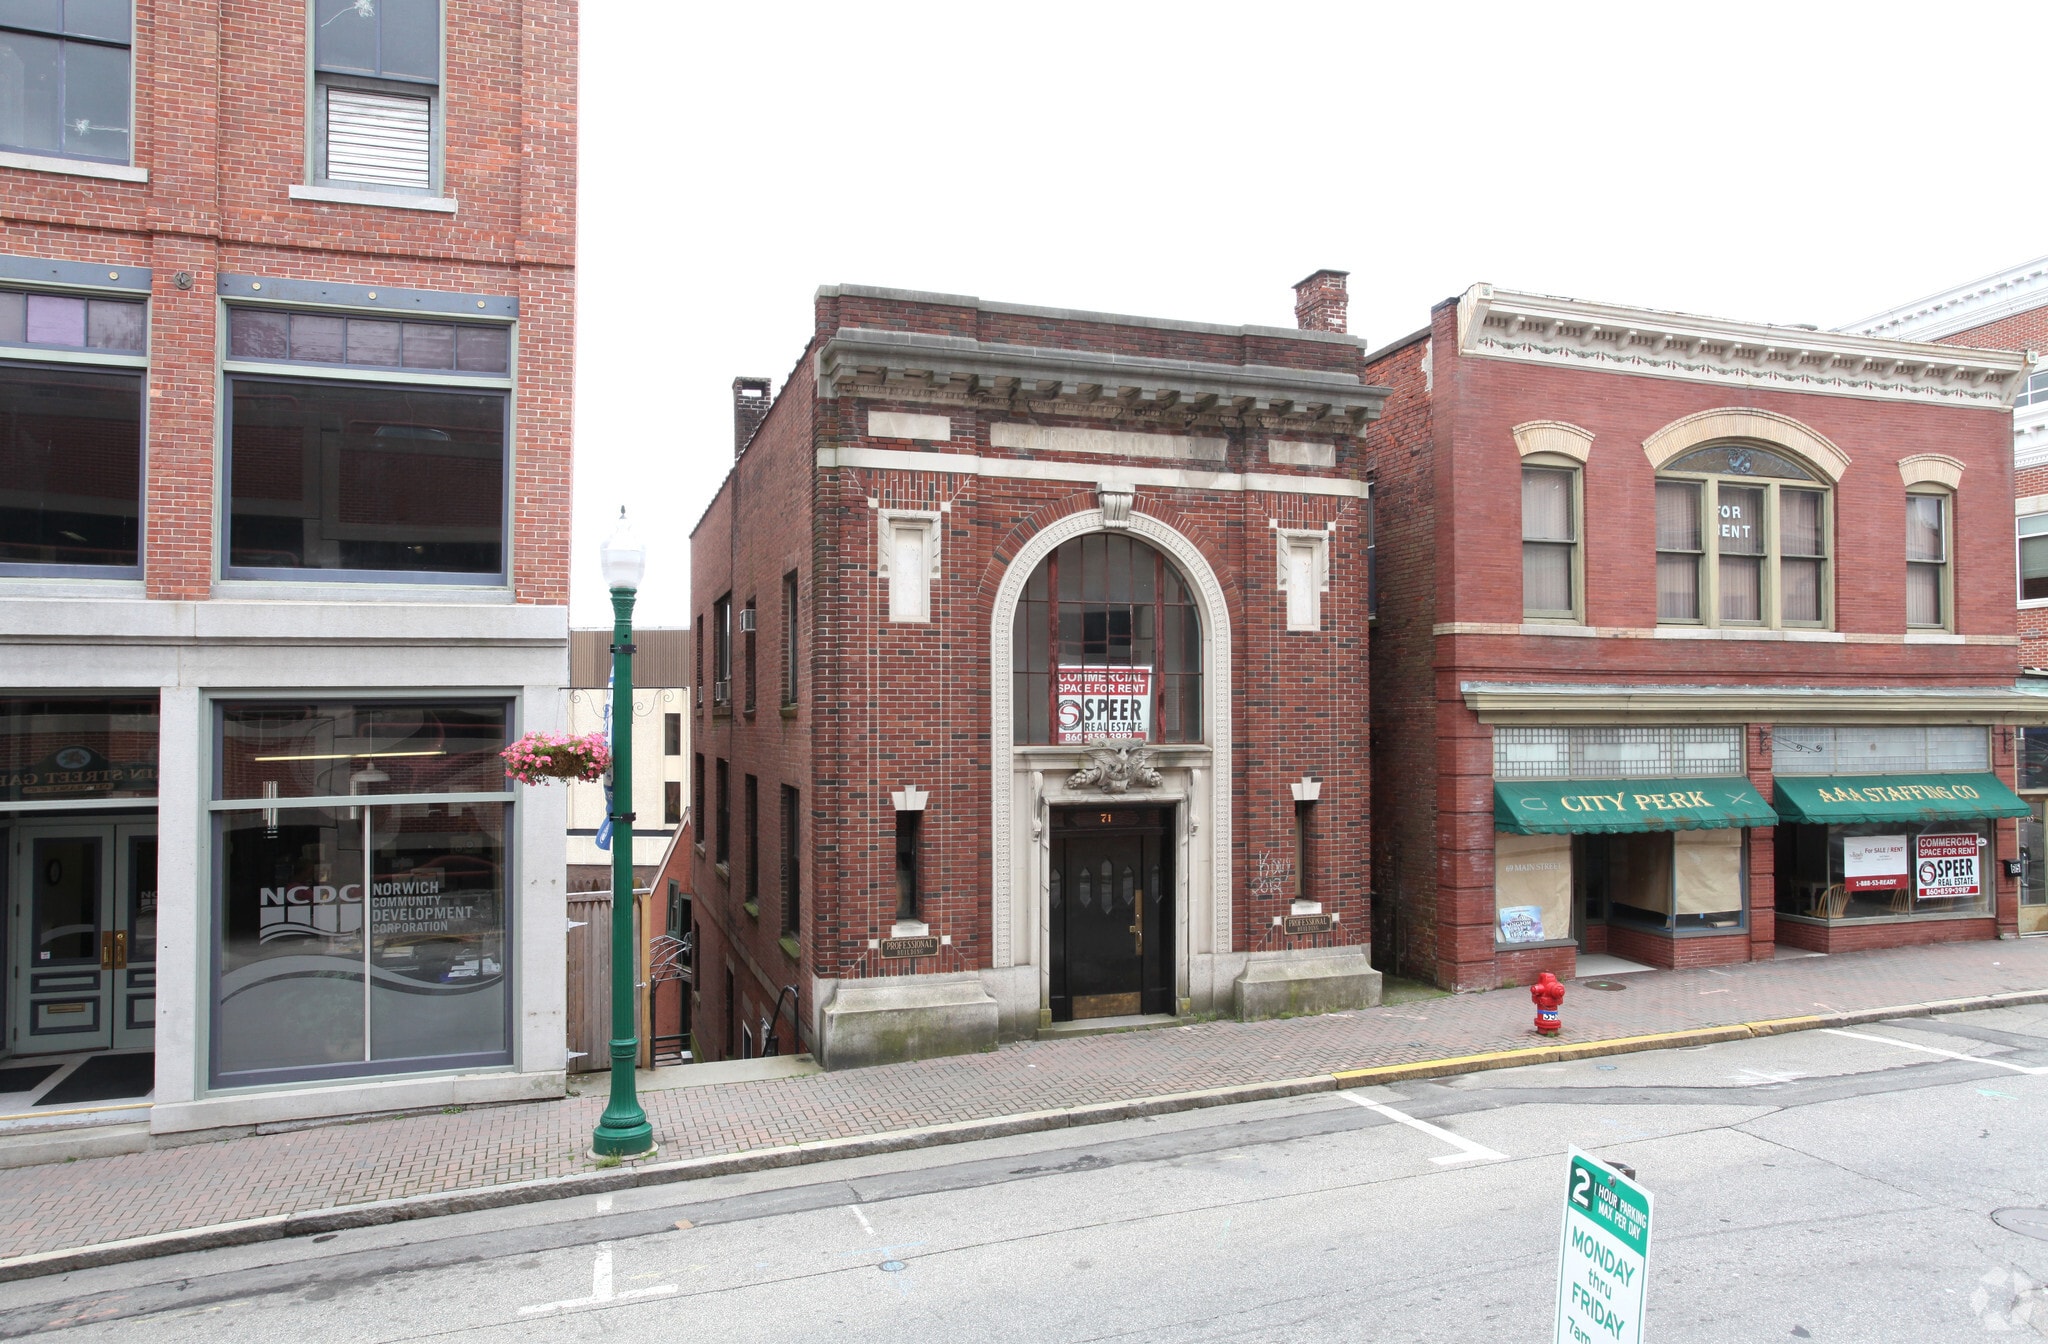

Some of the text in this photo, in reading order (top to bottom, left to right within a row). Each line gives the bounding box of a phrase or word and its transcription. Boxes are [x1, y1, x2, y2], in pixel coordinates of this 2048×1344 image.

[1718, 524, 1751, 539] ENT
[1059, 671, 1145, 682] COMMERCIAL
[1059, 684, 1146, 693] SPACE FOR RENT
[1085, 698, 1142, 721] SPEER
[1085, 722, 1107, 732] REAL
[1111, 722, 1142, 732] ESTATE
[1560, 791, 1715, 812] CITY PERK
[1817, 785, 1981, 803] AAA STAFFING CO
[1100, 813, 1112, 823] 71
[1920, 837, 1976, 848] COMMERCIAL
[1920, 847, 1976, 857] SPACE FOR RENT
[1514, 863, 1535, 873] MAIN
[1535, 862, 1561, 871] STREET
[1937, 858, 1974, 878] SPEER
[373, 881, 439, 896] NORWICH
[1937, 877, 1974, 887] REAL ESTATE
[260, 884, 363, 906] NCDC
[372, 895, 441, 907] COMMUNITY
[372, 906, 473, 922] DEVELOPMENT
[372, 920, 448, 934] CORPORATION
[1288, 916, 1327, 928] PROFESSIONAL
[886, 939, 933, 951] PROFESSIONAL
[1573, 1168, 1647, 1229] 2 HOUR PARKING
[1598, 1200, 1641, 1241] MAX PER DAY
[1571, 1225, 1635, 1288] MONDAY
[1588, 1267, 1612, 1301] thru
[1571, 1281, 1625, 1341] FRIDAY
